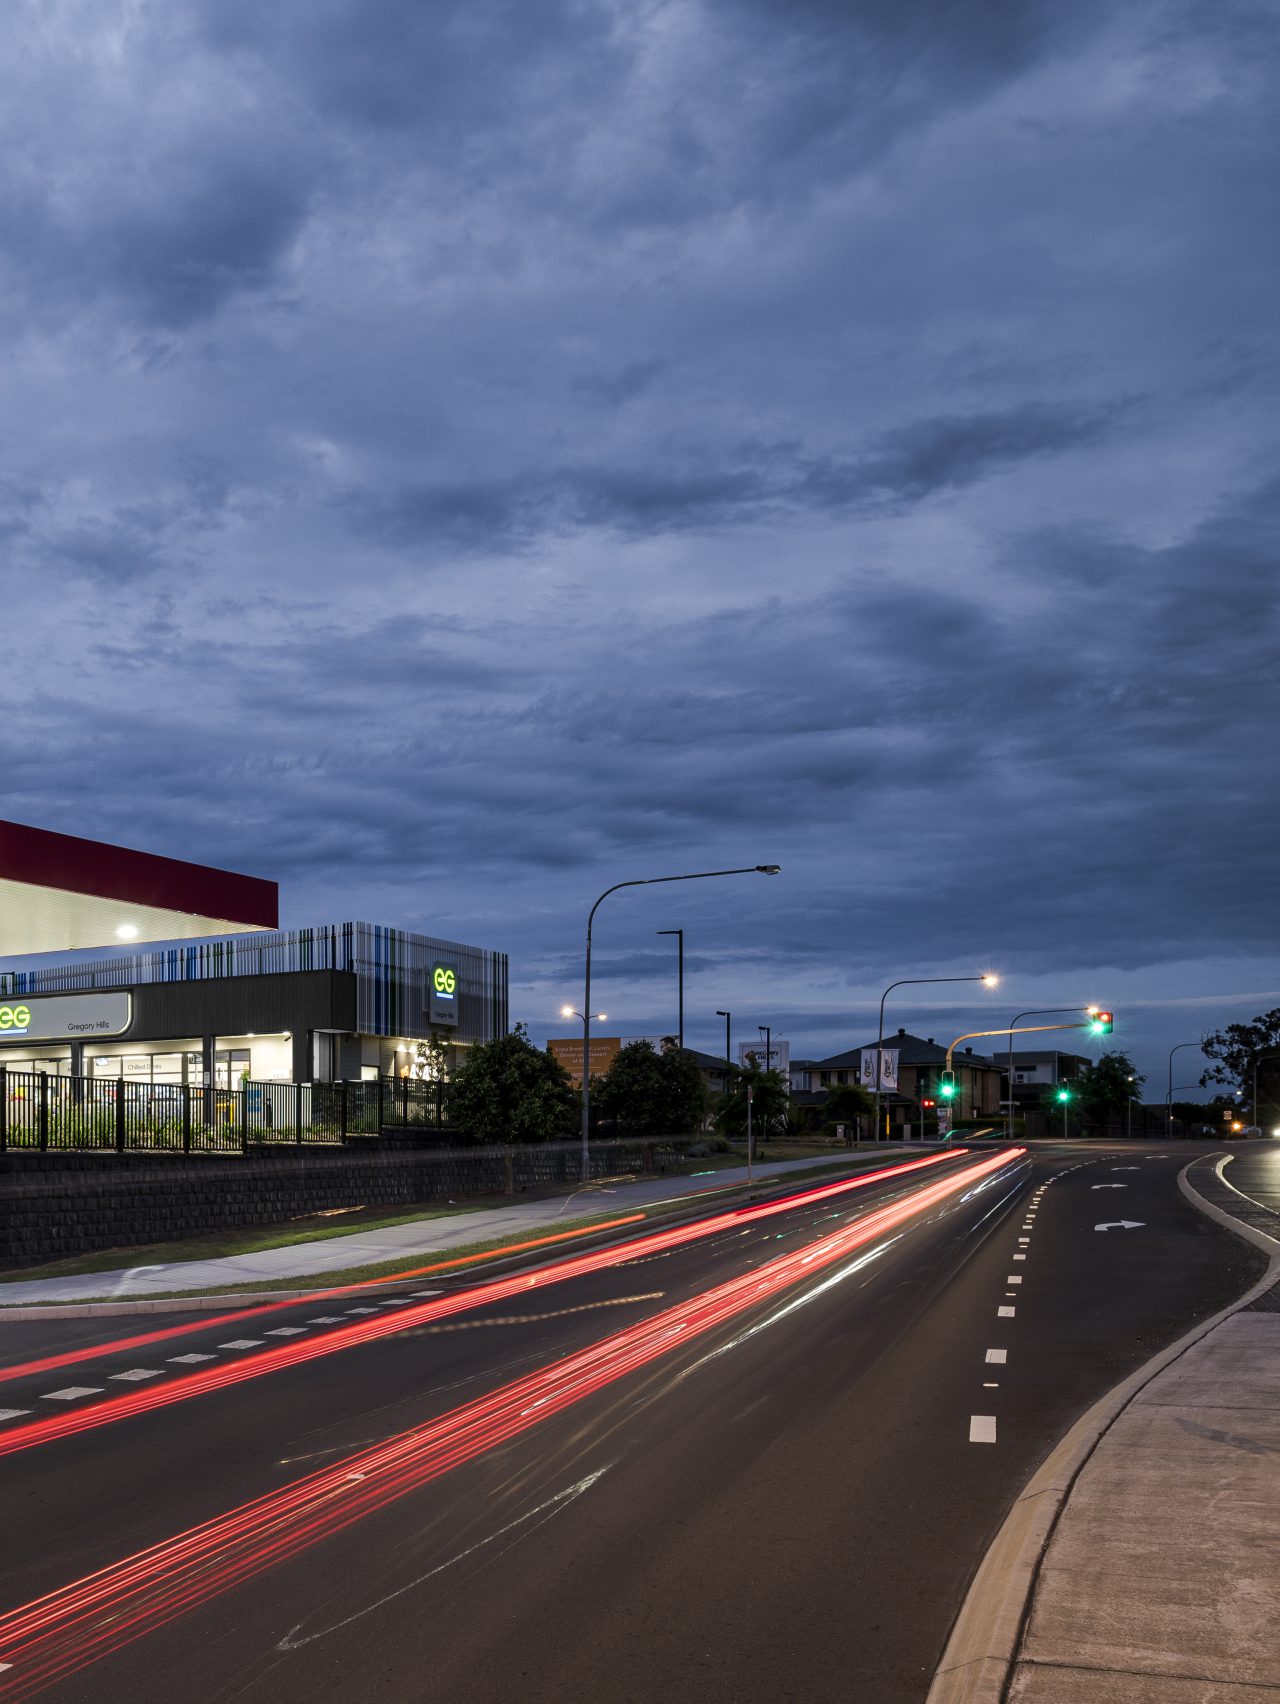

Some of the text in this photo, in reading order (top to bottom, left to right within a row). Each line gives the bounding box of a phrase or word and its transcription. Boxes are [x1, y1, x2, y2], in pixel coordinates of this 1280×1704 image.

[68, 1020, 110, 1031] Gregory Hills
[128, 1063, 146, 1071] Chilled
